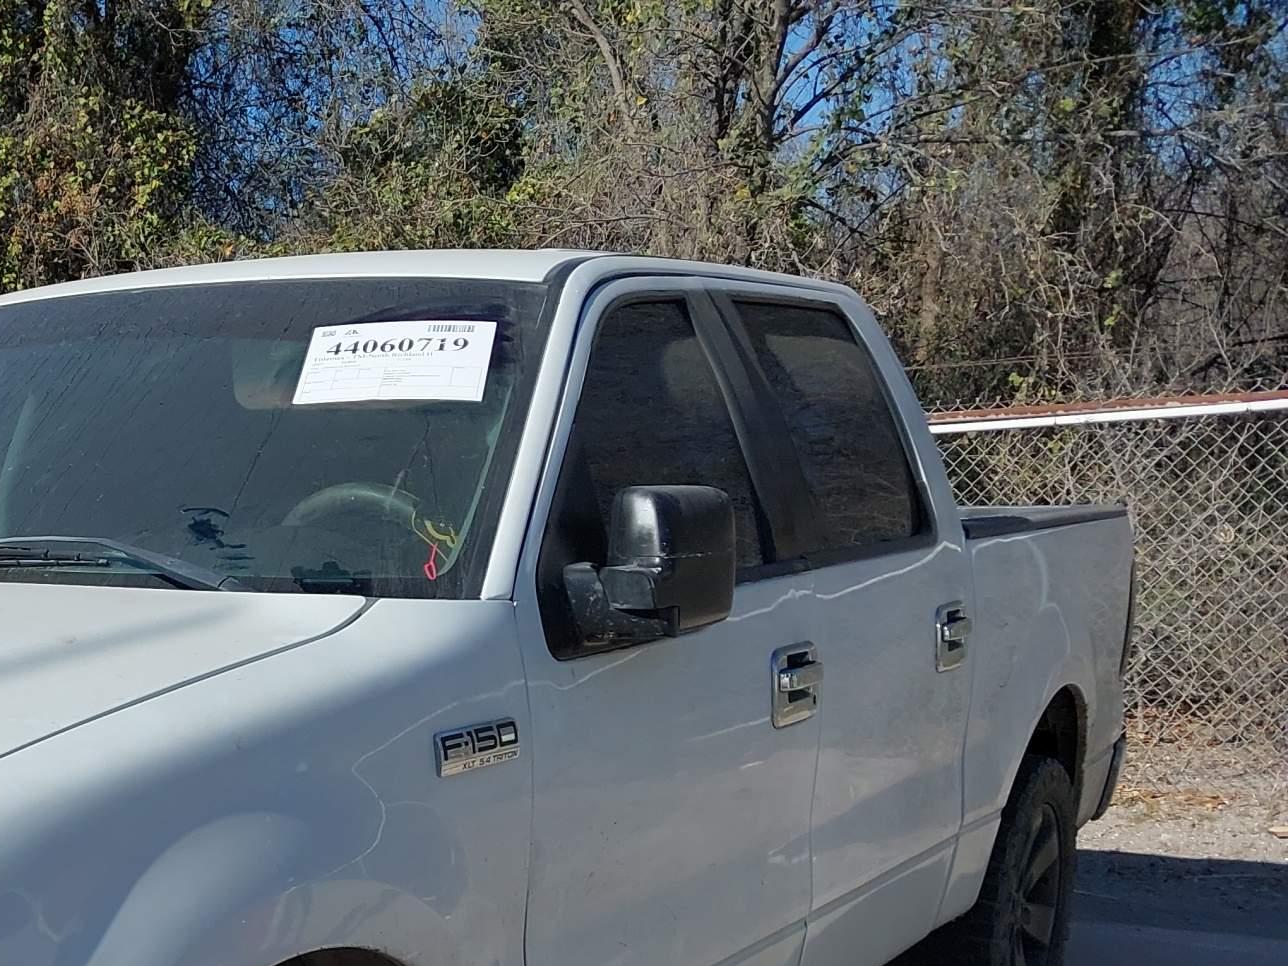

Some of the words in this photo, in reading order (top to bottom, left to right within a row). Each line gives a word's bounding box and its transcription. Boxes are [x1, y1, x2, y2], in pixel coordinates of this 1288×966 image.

[326, 337, 470, 356] 44060719
[462, 760, 476, 770] XLT
[492, 750, 518, 762] TRITON
